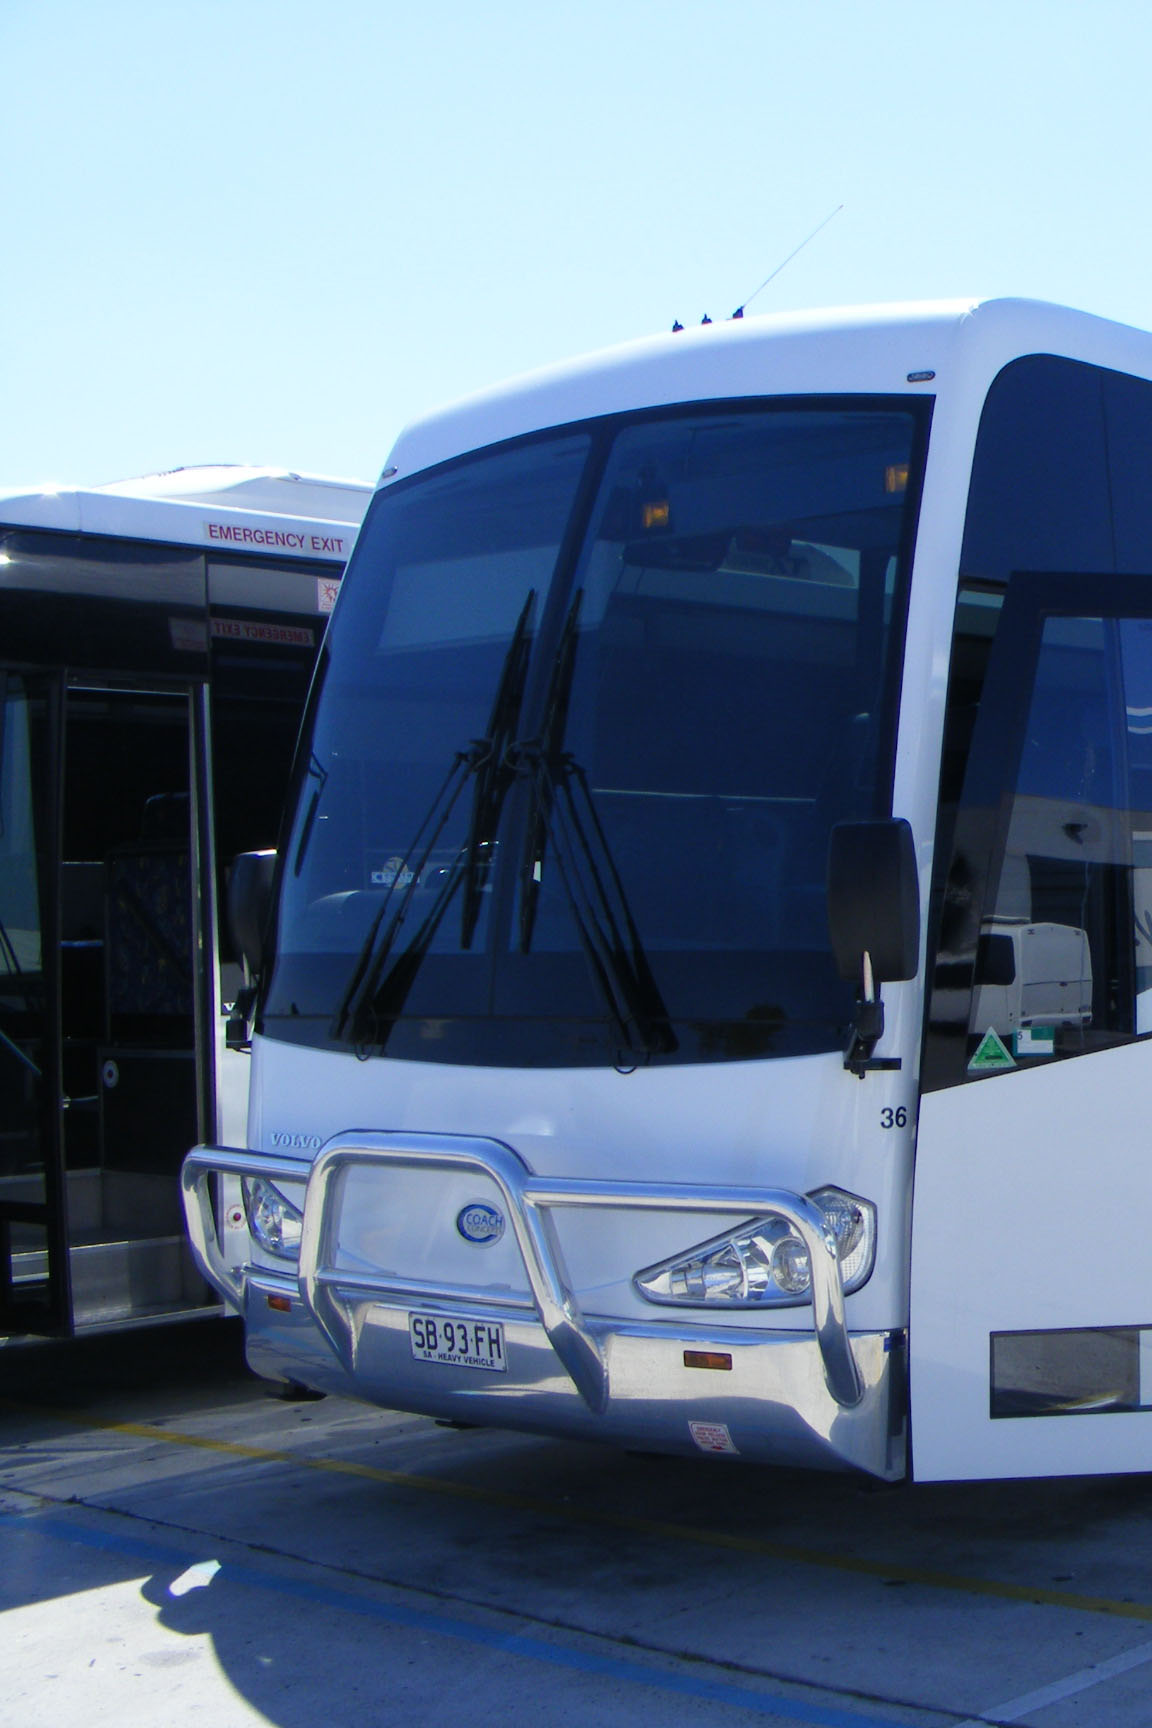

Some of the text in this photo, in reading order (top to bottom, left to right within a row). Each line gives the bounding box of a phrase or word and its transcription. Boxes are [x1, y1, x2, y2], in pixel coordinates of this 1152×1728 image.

[208, 523, 344, 552] EMERGENCY EXIT
[880, 1105, 907, 1129] 36
[271, 1132, 322, 1149] VOLVO
[466, 1213, 503, 1227] COACH
[438, 1352, 461, 1363] HEAVY
[464, 1356, 496, 1368] VEHICLE
